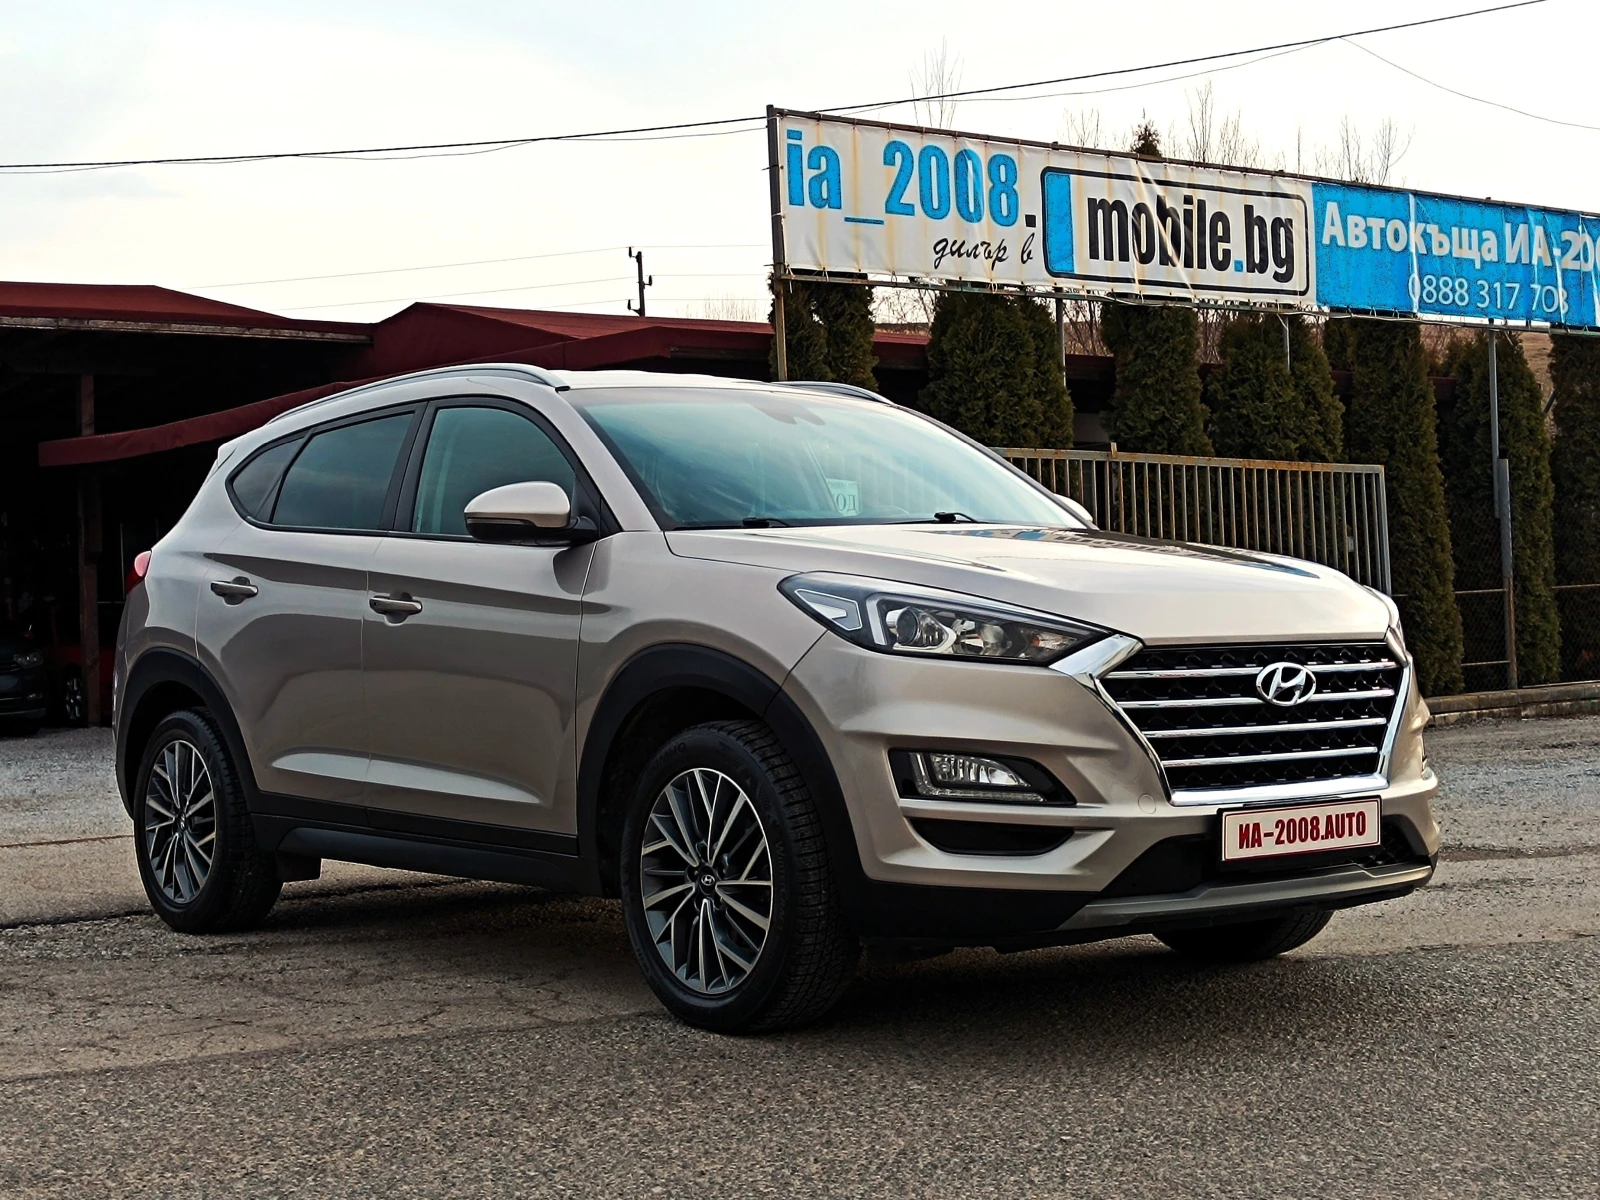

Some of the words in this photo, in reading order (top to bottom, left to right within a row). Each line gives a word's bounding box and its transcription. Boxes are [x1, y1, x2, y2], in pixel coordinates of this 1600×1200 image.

[1088, 194, 1295, 284] mobile.bg
[1322, 201, 1499, 270] Автокъща
[1408, 273, 1470, 307] 0888
[1476, 279, 1520, 310] 317
